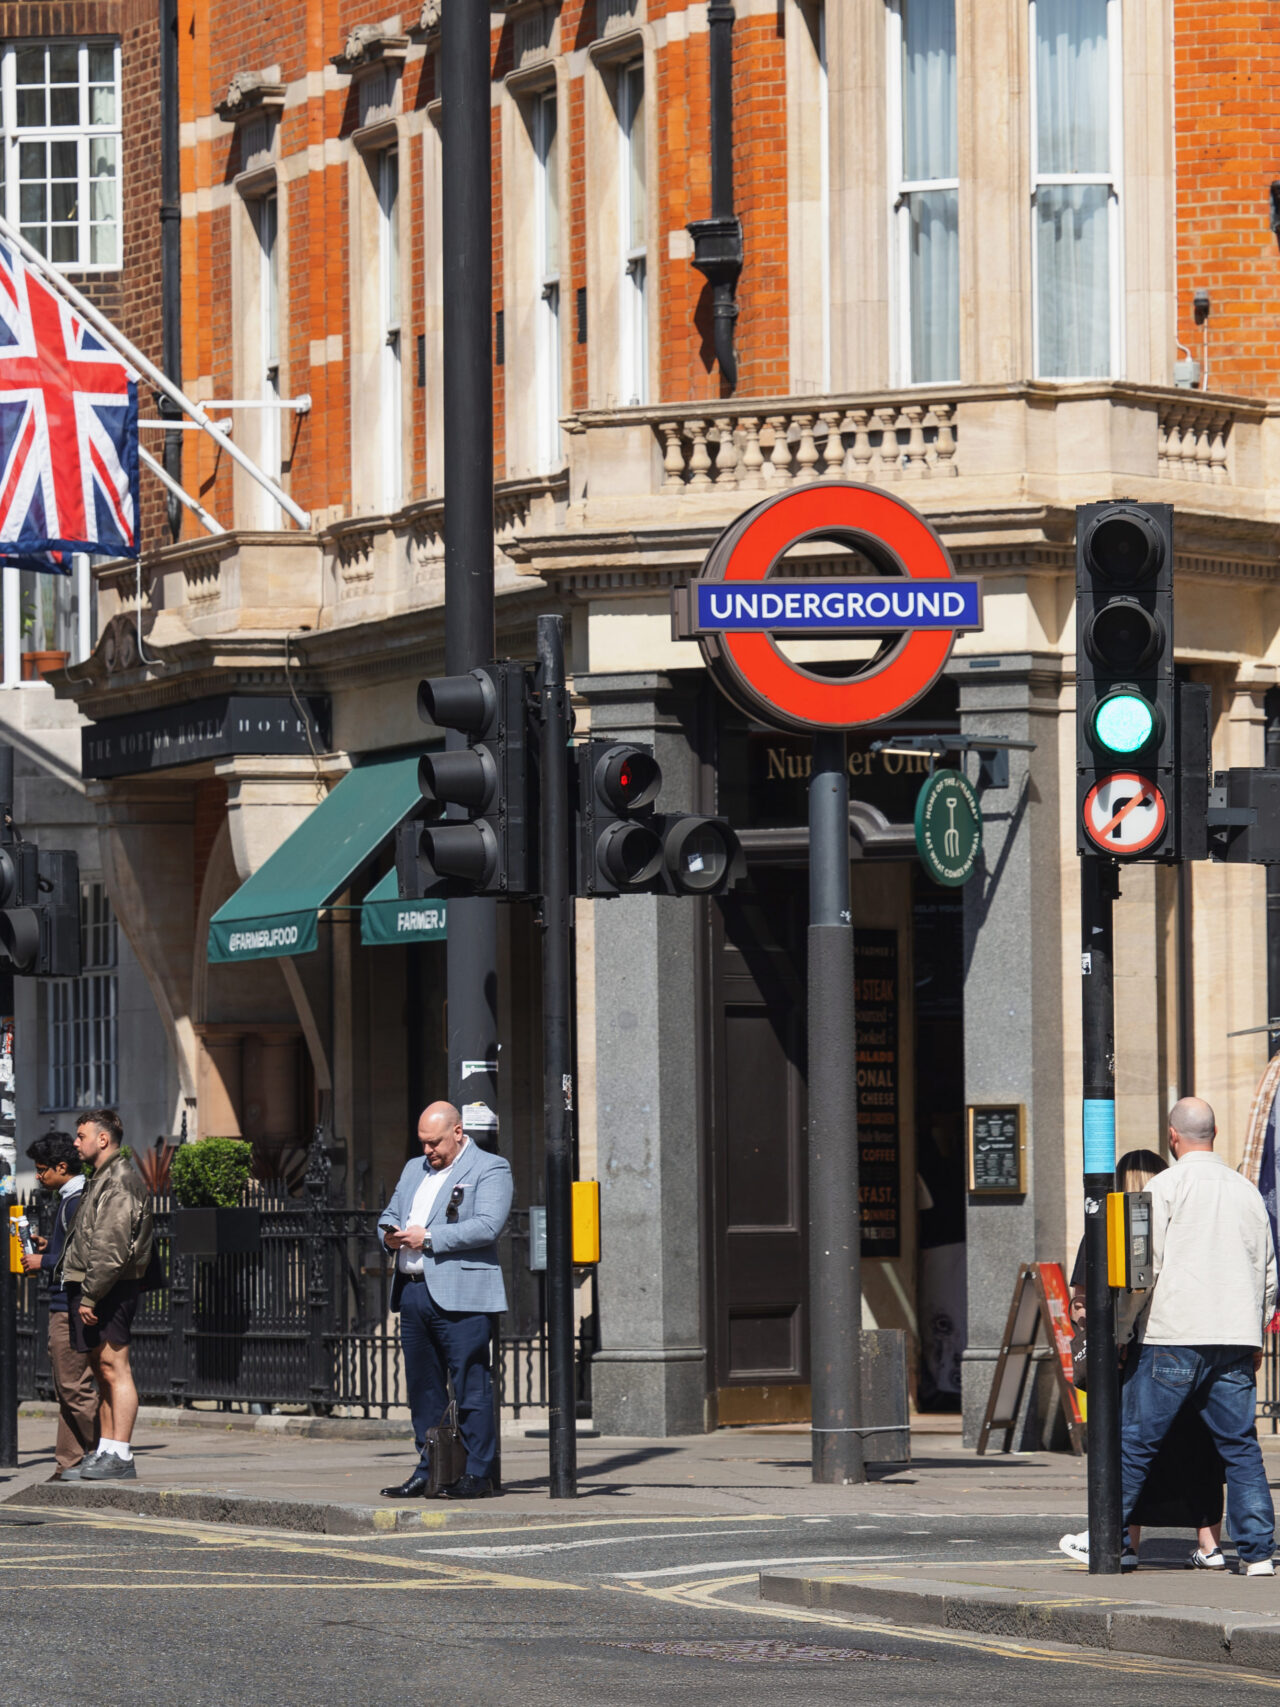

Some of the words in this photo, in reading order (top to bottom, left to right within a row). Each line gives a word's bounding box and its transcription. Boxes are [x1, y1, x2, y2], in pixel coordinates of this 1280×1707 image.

[710, 591, 965, 619] UNDERGROUND
[88, 739, 112, 761] THE
[178, 719, 224, 745] HOTEL
[767, 748, 876, 779] Nuer
[944, 778, 956, 787] THE
[397, 910, 438, 932] FARMER
[229, 926, 298, 952] @FARMERJFOOD
[863, 979, 895, 1000] STEAK
[856, 1069, 894, 1087] ONAL
[861, 1093, 895, 1106] CHEESE
[862, 1148, 896, 1161] COFFEE
[1073, 1346, 1087, 1362] TOT
